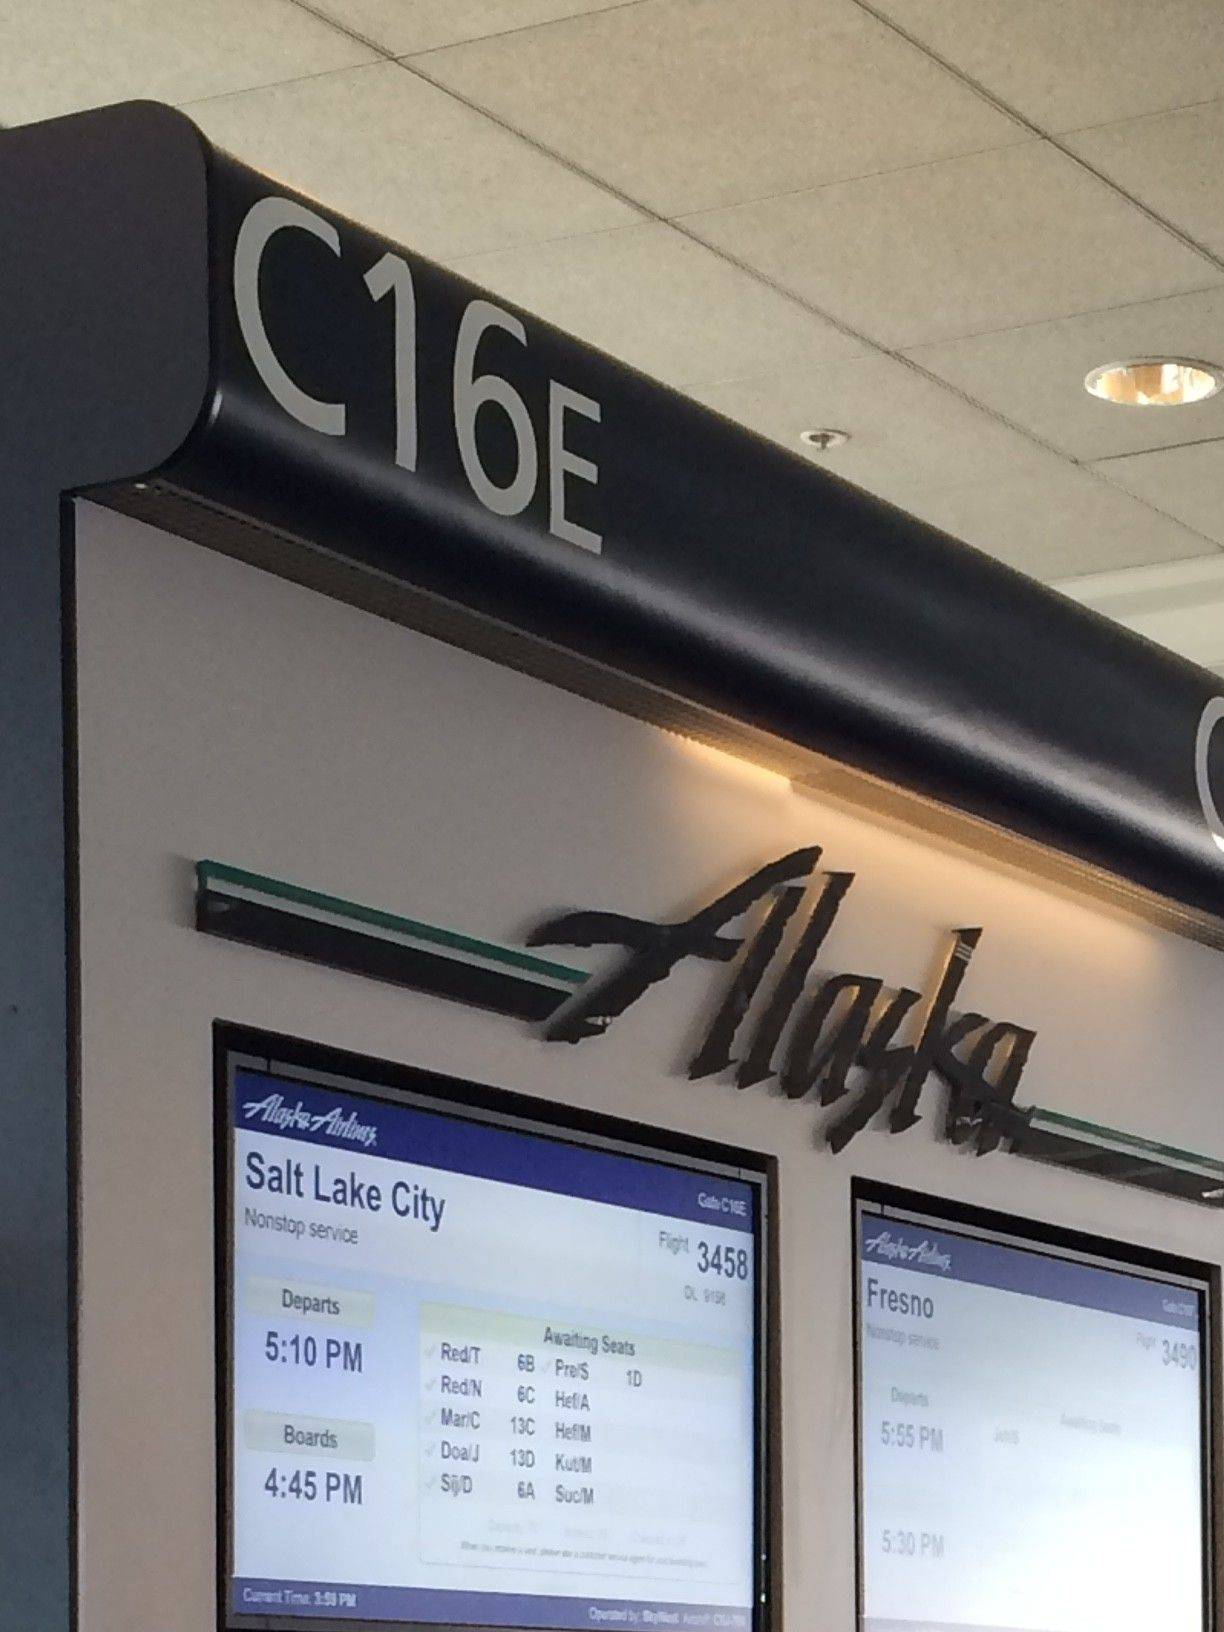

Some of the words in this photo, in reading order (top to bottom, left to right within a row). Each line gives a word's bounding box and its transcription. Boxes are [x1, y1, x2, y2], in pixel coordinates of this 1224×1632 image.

[233, 196, 602, 555] C16E
[526, 844, 1038, 1156] Alaska
[243, 1093, 311, 1130] Alaska
[246, 1151, 304, 1198] Salt
[315, 1164, 382, 1212] Lake
[392, 1181, 445, 1232] City
[245, 1207, 305, 1239] Nonstop
[311, 1222, 358, 1244] service
[697, 1241, 748, 1280] 3458
[282, 1288, 340, 1315] Departs
[866, 1277, 934, 1319] Fresno
[265, 1331, 317, 1366] 5:10
[326, 1338, 363, 1373] PM
[543, 1326, 599, 1355] Awaiting
[601, 1335, 636, 1356] Seats
[441, 1342, 481, 1364] Red/T
[626, 1369, 643, 1387] 1D
[441, 1375, 482, 1397] Red/N
[283, 1424, 338, 1449] Boards
[441, 1407, 481, 1429] Mar/C
[881, 1420, 915, 1449] 5:55
[919, 1425, 944, 1452] PM
[264, 1467, 317, 1501] 4:45
[326, 1472, 363, 1505] PM
[881, 1529, 915, 1556] 5:30
[920, 1533, 944, 1558] PM
